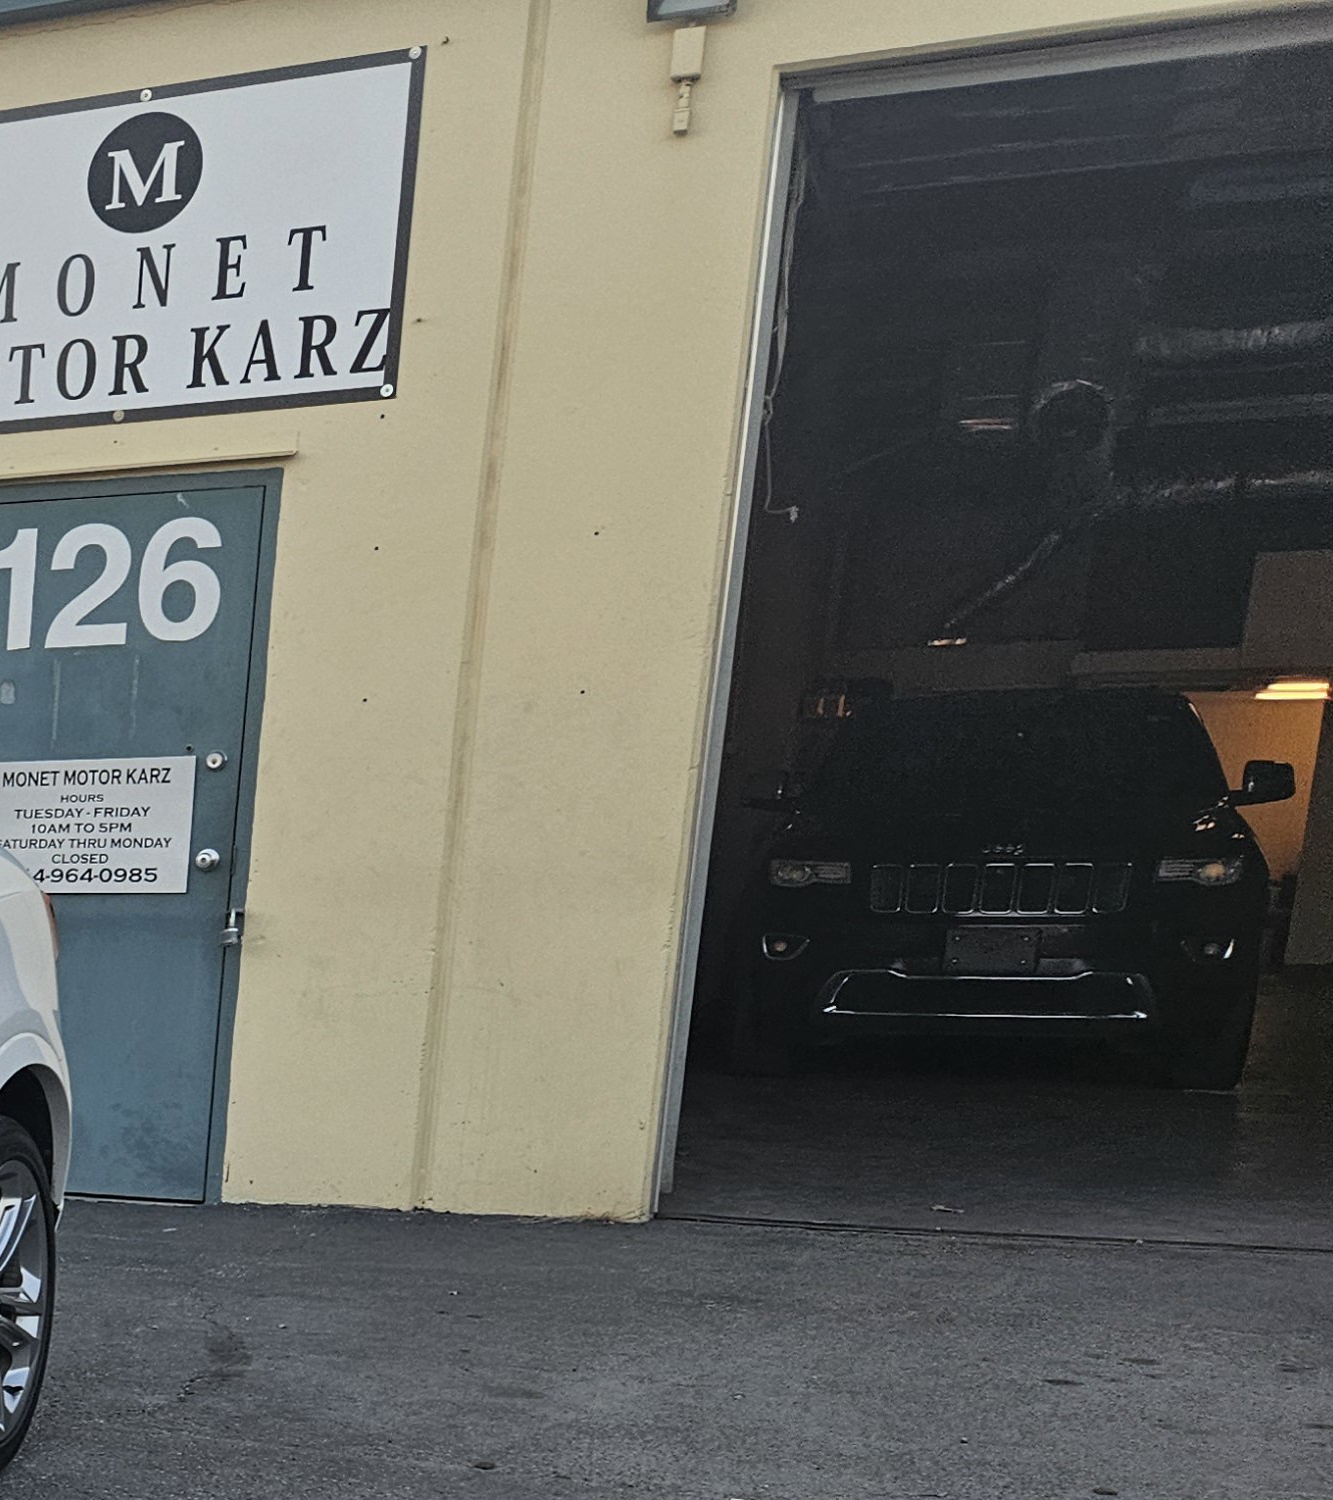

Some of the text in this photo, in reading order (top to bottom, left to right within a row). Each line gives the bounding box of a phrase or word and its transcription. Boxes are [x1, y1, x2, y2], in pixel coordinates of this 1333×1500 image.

[104, 139, 186, 211] M
[185, 307, 391, 389] KARZ
[2, 768, 171, 788] MONET MOTOR KARZ
[60, 793, 104, 803] HOURS
[14, 808, 83, 819] TUESDAY
[93, 806, 151, 818] FRIDAY
[31, 822, 132, 834] 10AM TO 5PM
[69, 838, 107, 849] THRU
[110, 837, 172, 848] MONDAY
[51, 853, 109, 864] CLOSED
[27, 867, 158, 883] 4-964-0985
